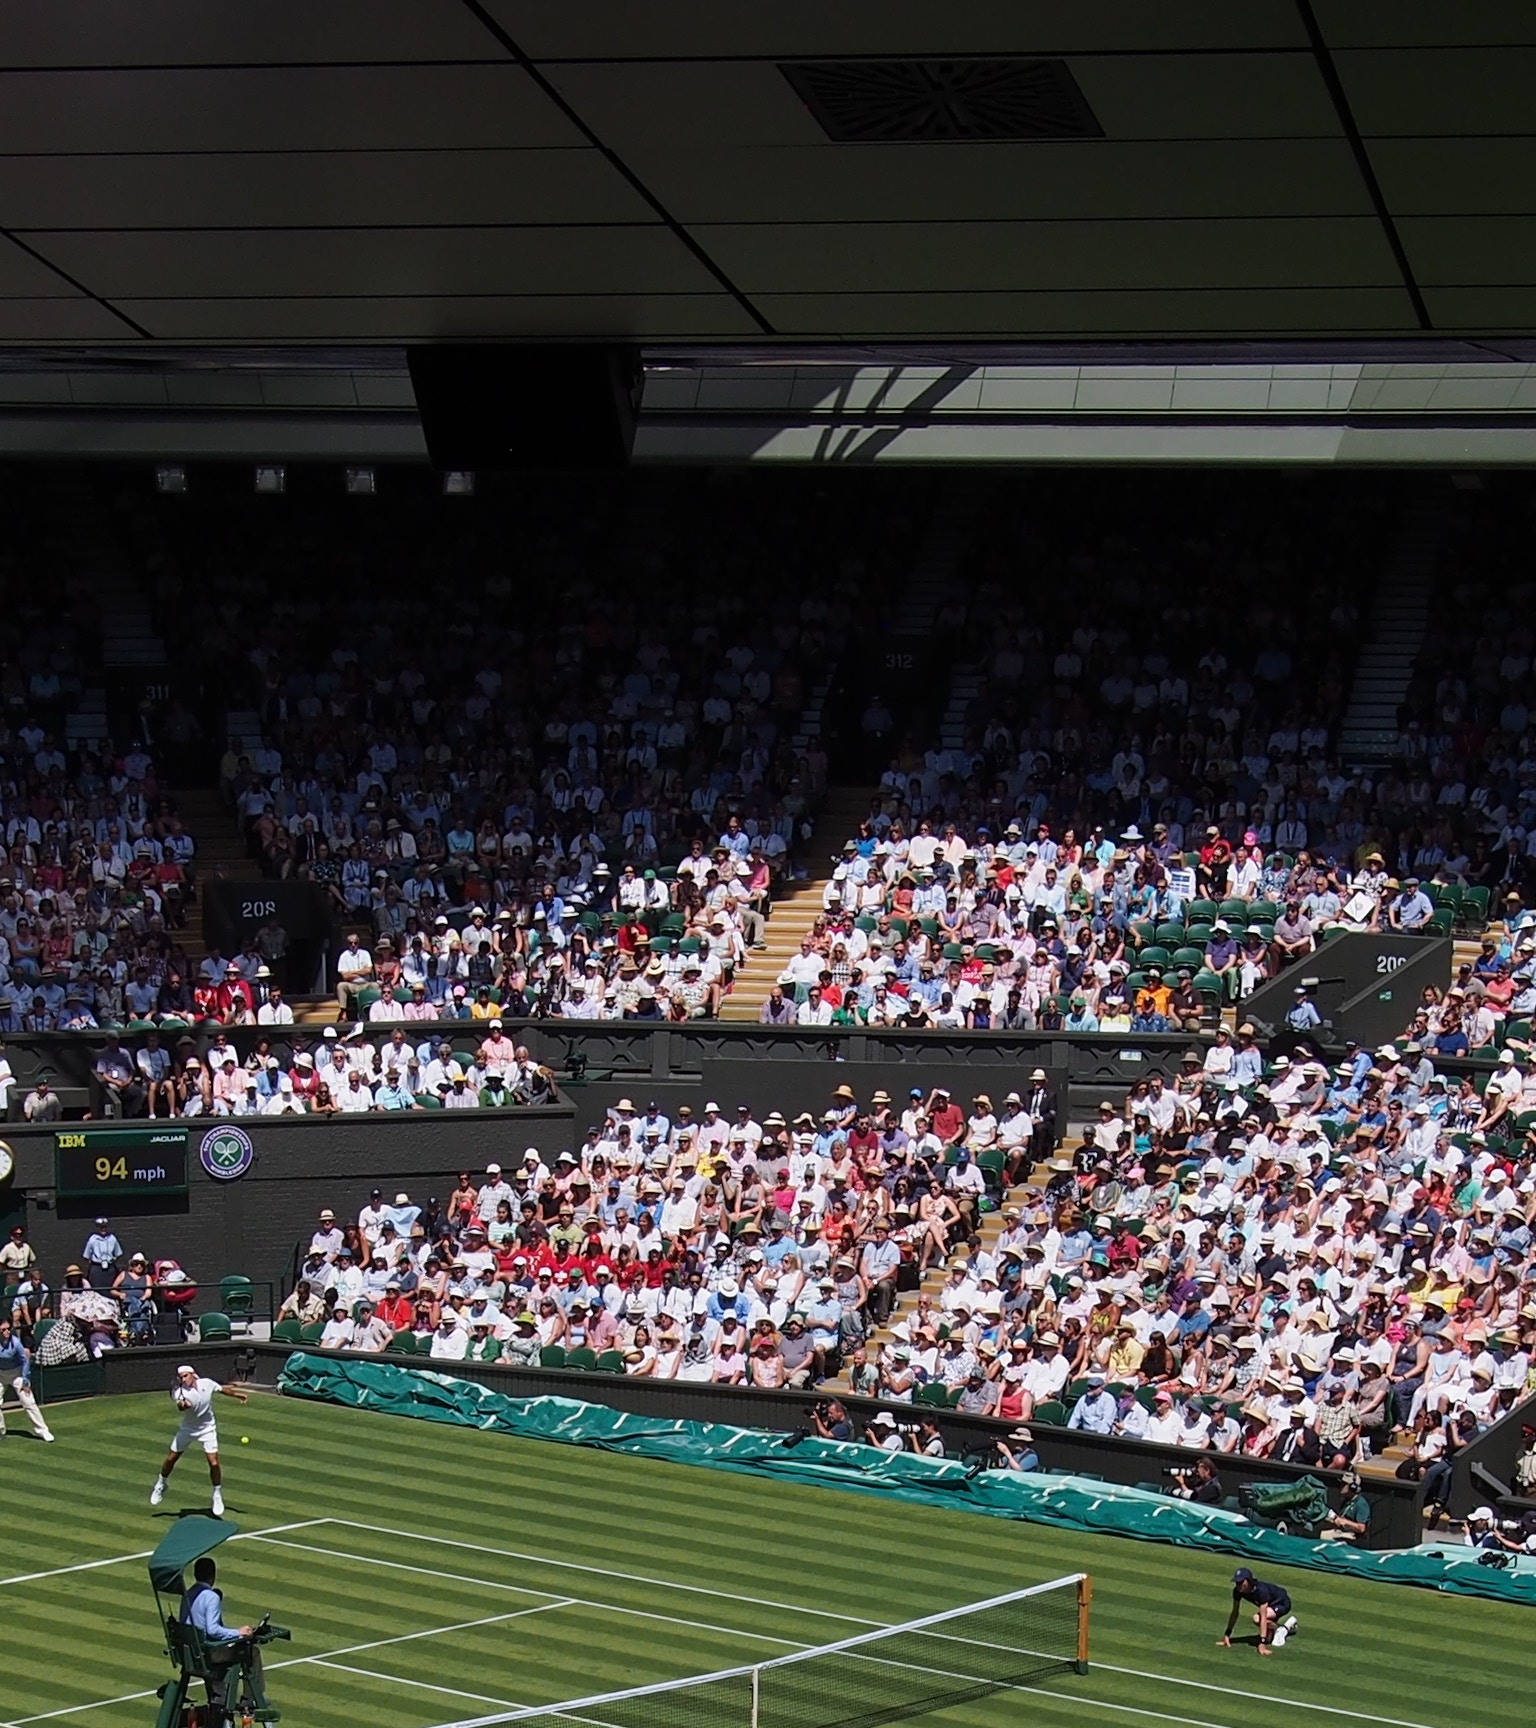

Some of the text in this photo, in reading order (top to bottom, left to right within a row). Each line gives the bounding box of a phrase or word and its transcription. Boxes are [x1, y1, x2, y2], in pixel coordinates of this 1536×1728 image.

[885, 653, 913, 668] 312
[146, 684, 170, 700] 311
[58, 1135, 86, 1148] IBM
[150, 1135, 186, 1143] JAGUAR
[95, 1156, 166, 1182] 94 mph
